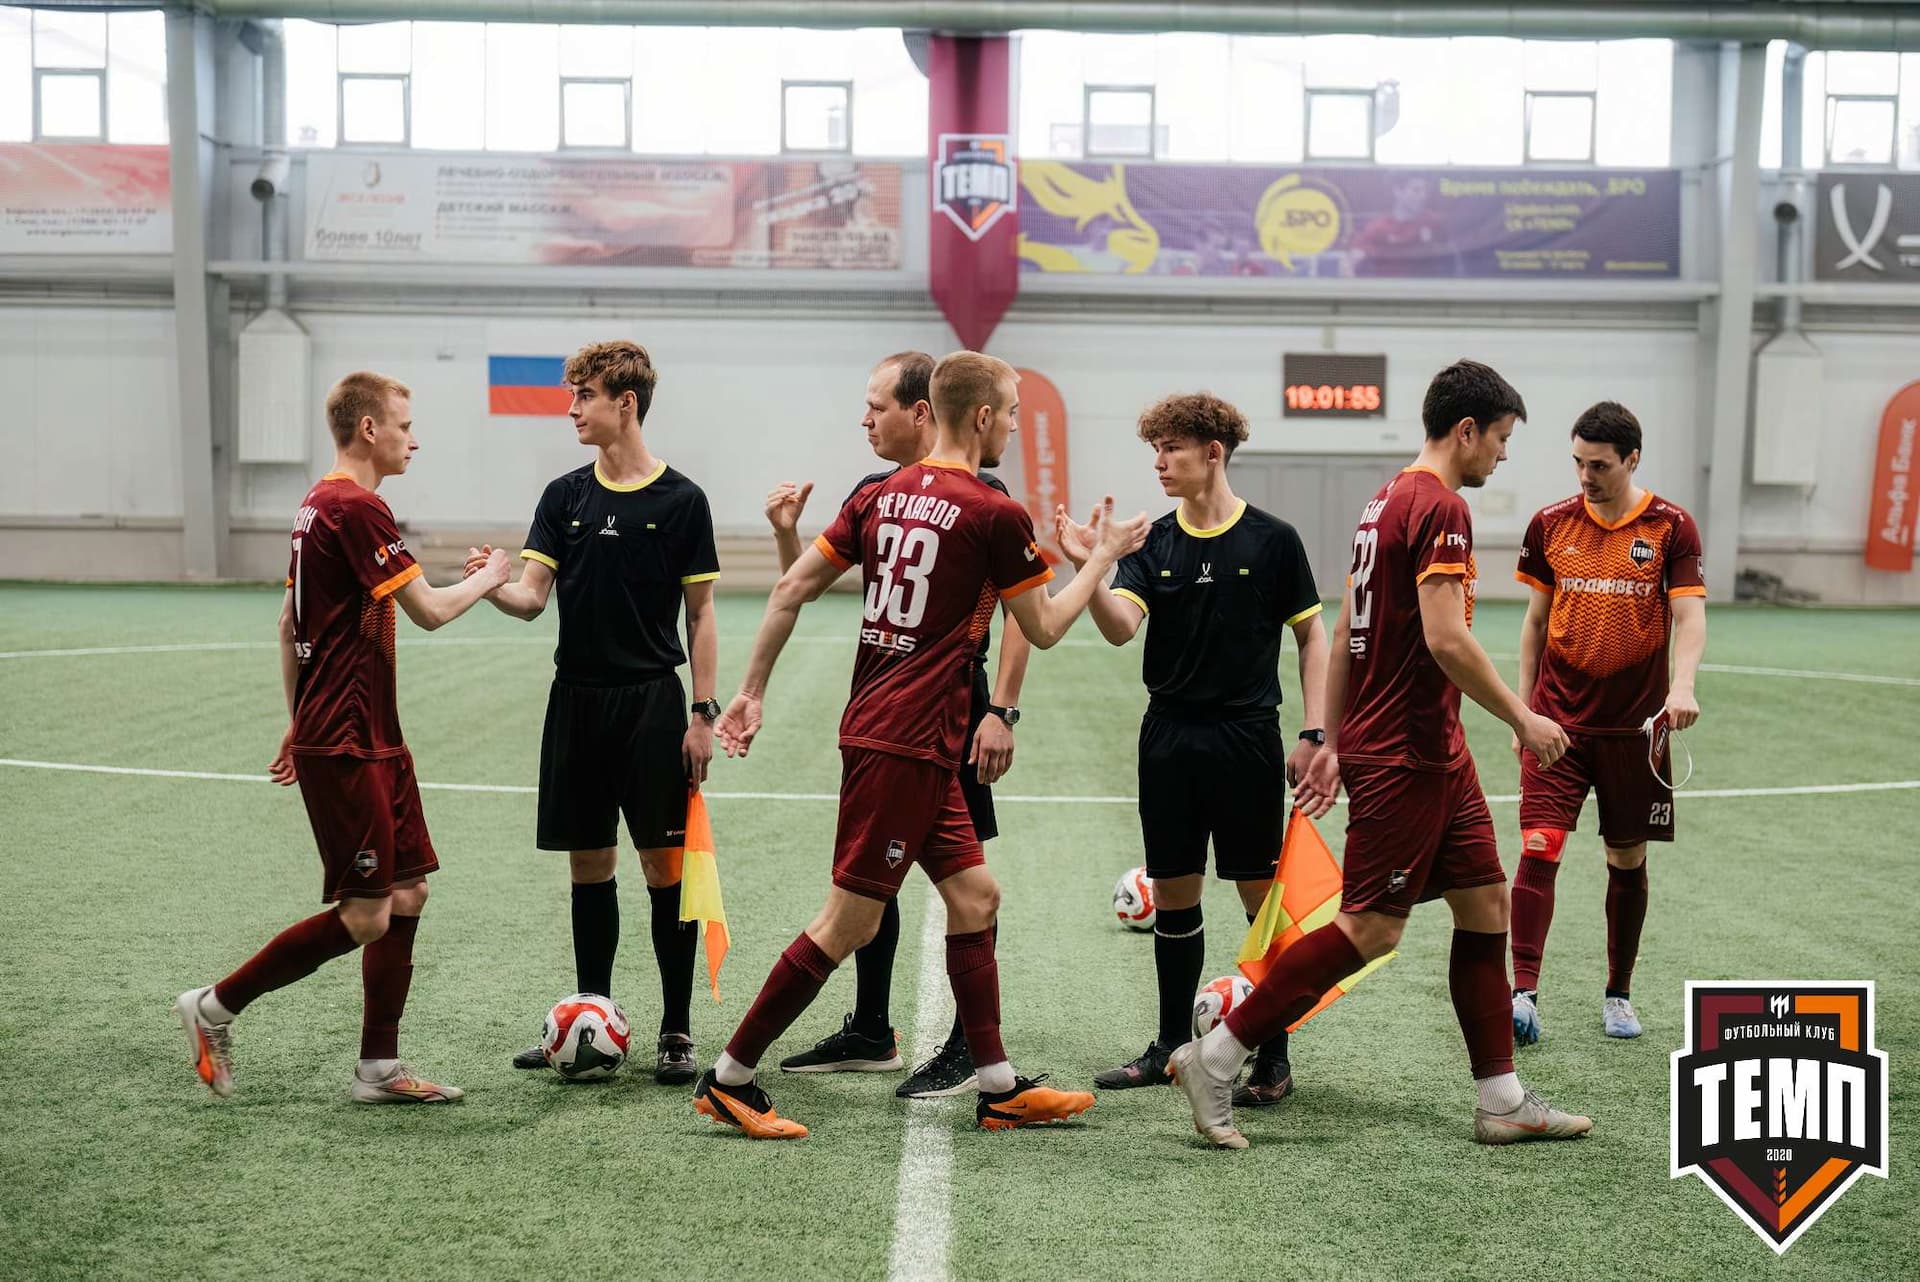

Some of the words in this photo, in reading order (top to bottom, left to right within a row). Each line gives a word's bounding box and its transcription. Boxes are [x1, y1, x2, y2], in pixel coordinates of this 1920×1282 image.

[1286, 384, 1380, 410] 19:01:55
[877, 492, 961, 531] ЧЕРКАСОВ
[864, 523, 939, 628] 33
[1649, 802, 1671, 826] 23
